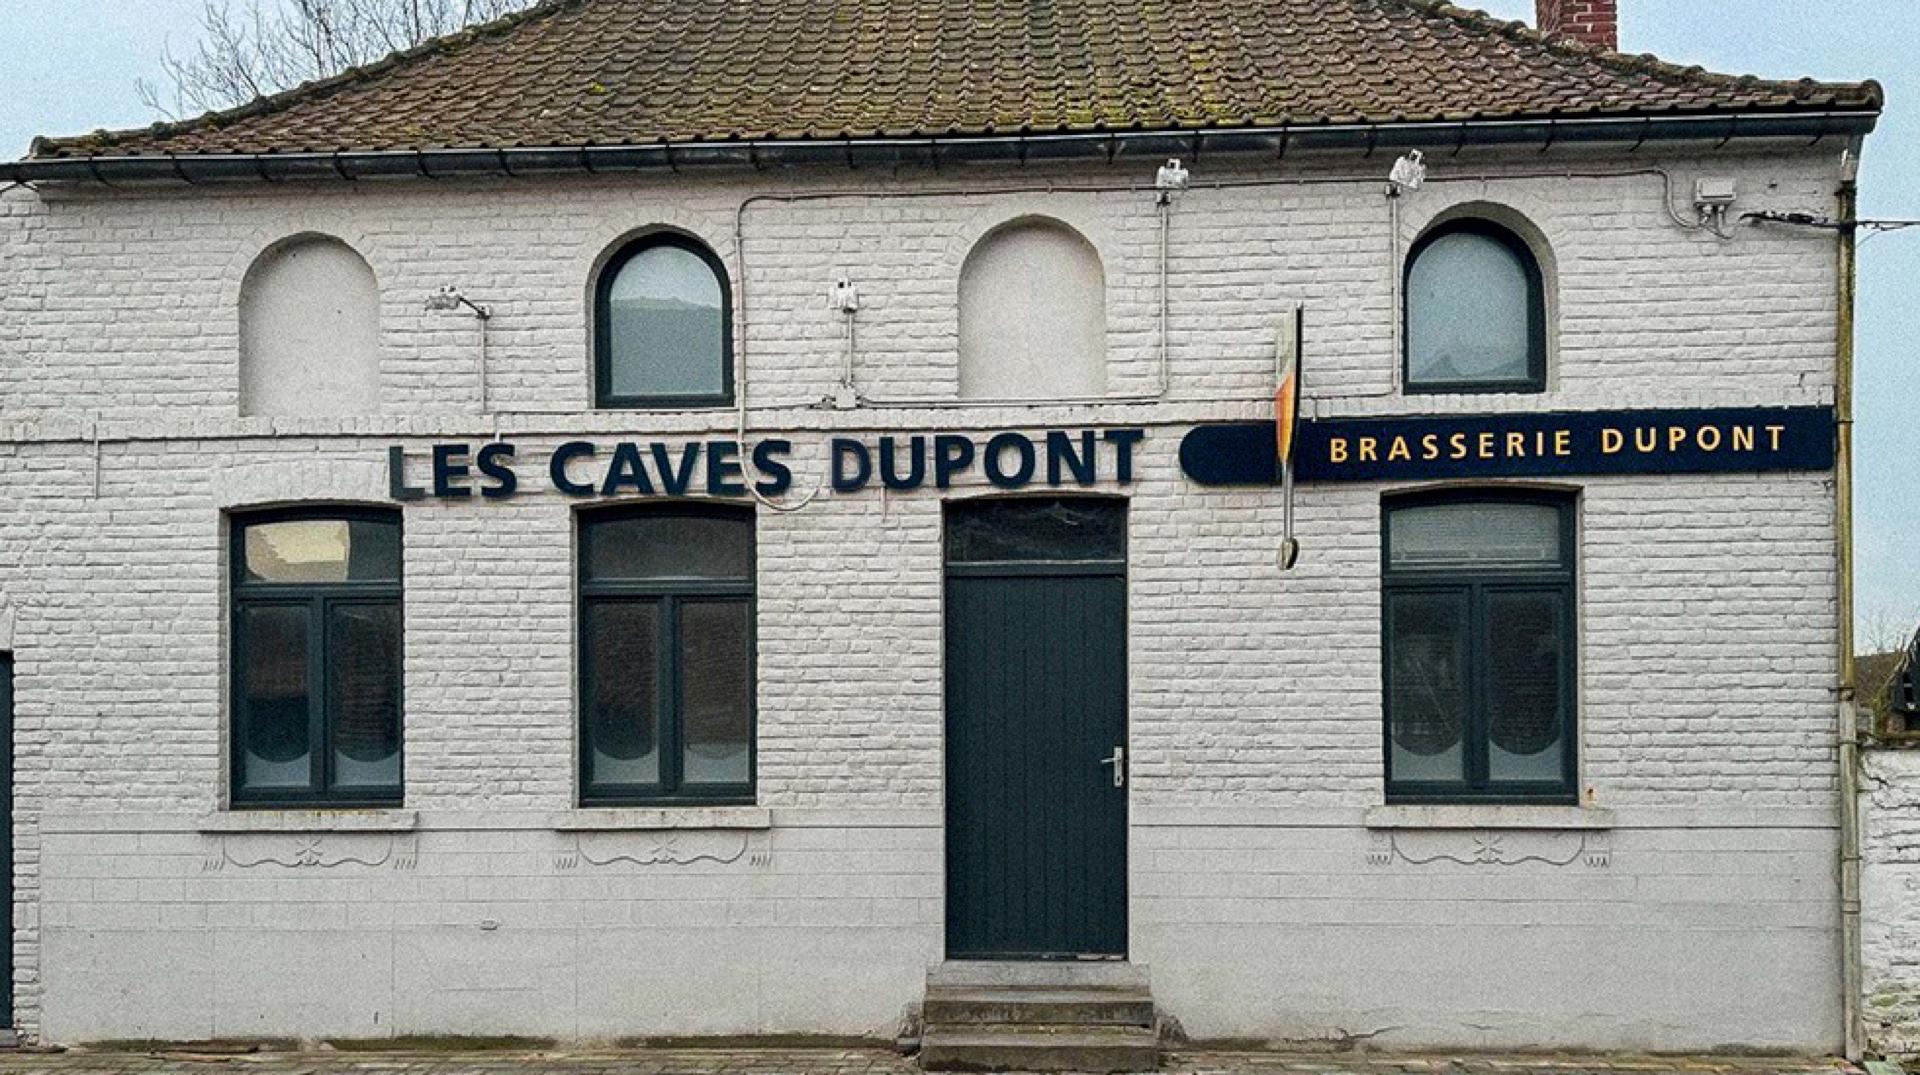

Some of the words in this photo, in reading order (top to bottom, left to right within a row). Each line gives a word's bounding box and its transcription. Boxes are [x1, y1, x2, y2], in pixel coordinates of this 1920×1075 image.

[389, 443, 518, 499] LES
[549, 439, 792, 498] CAVES
[831, 428, 1144, 492] DUPONT
[1330, 430, 1572, 463] BRASSERIE
[1602, 425, 1786, 453] DUPONT
